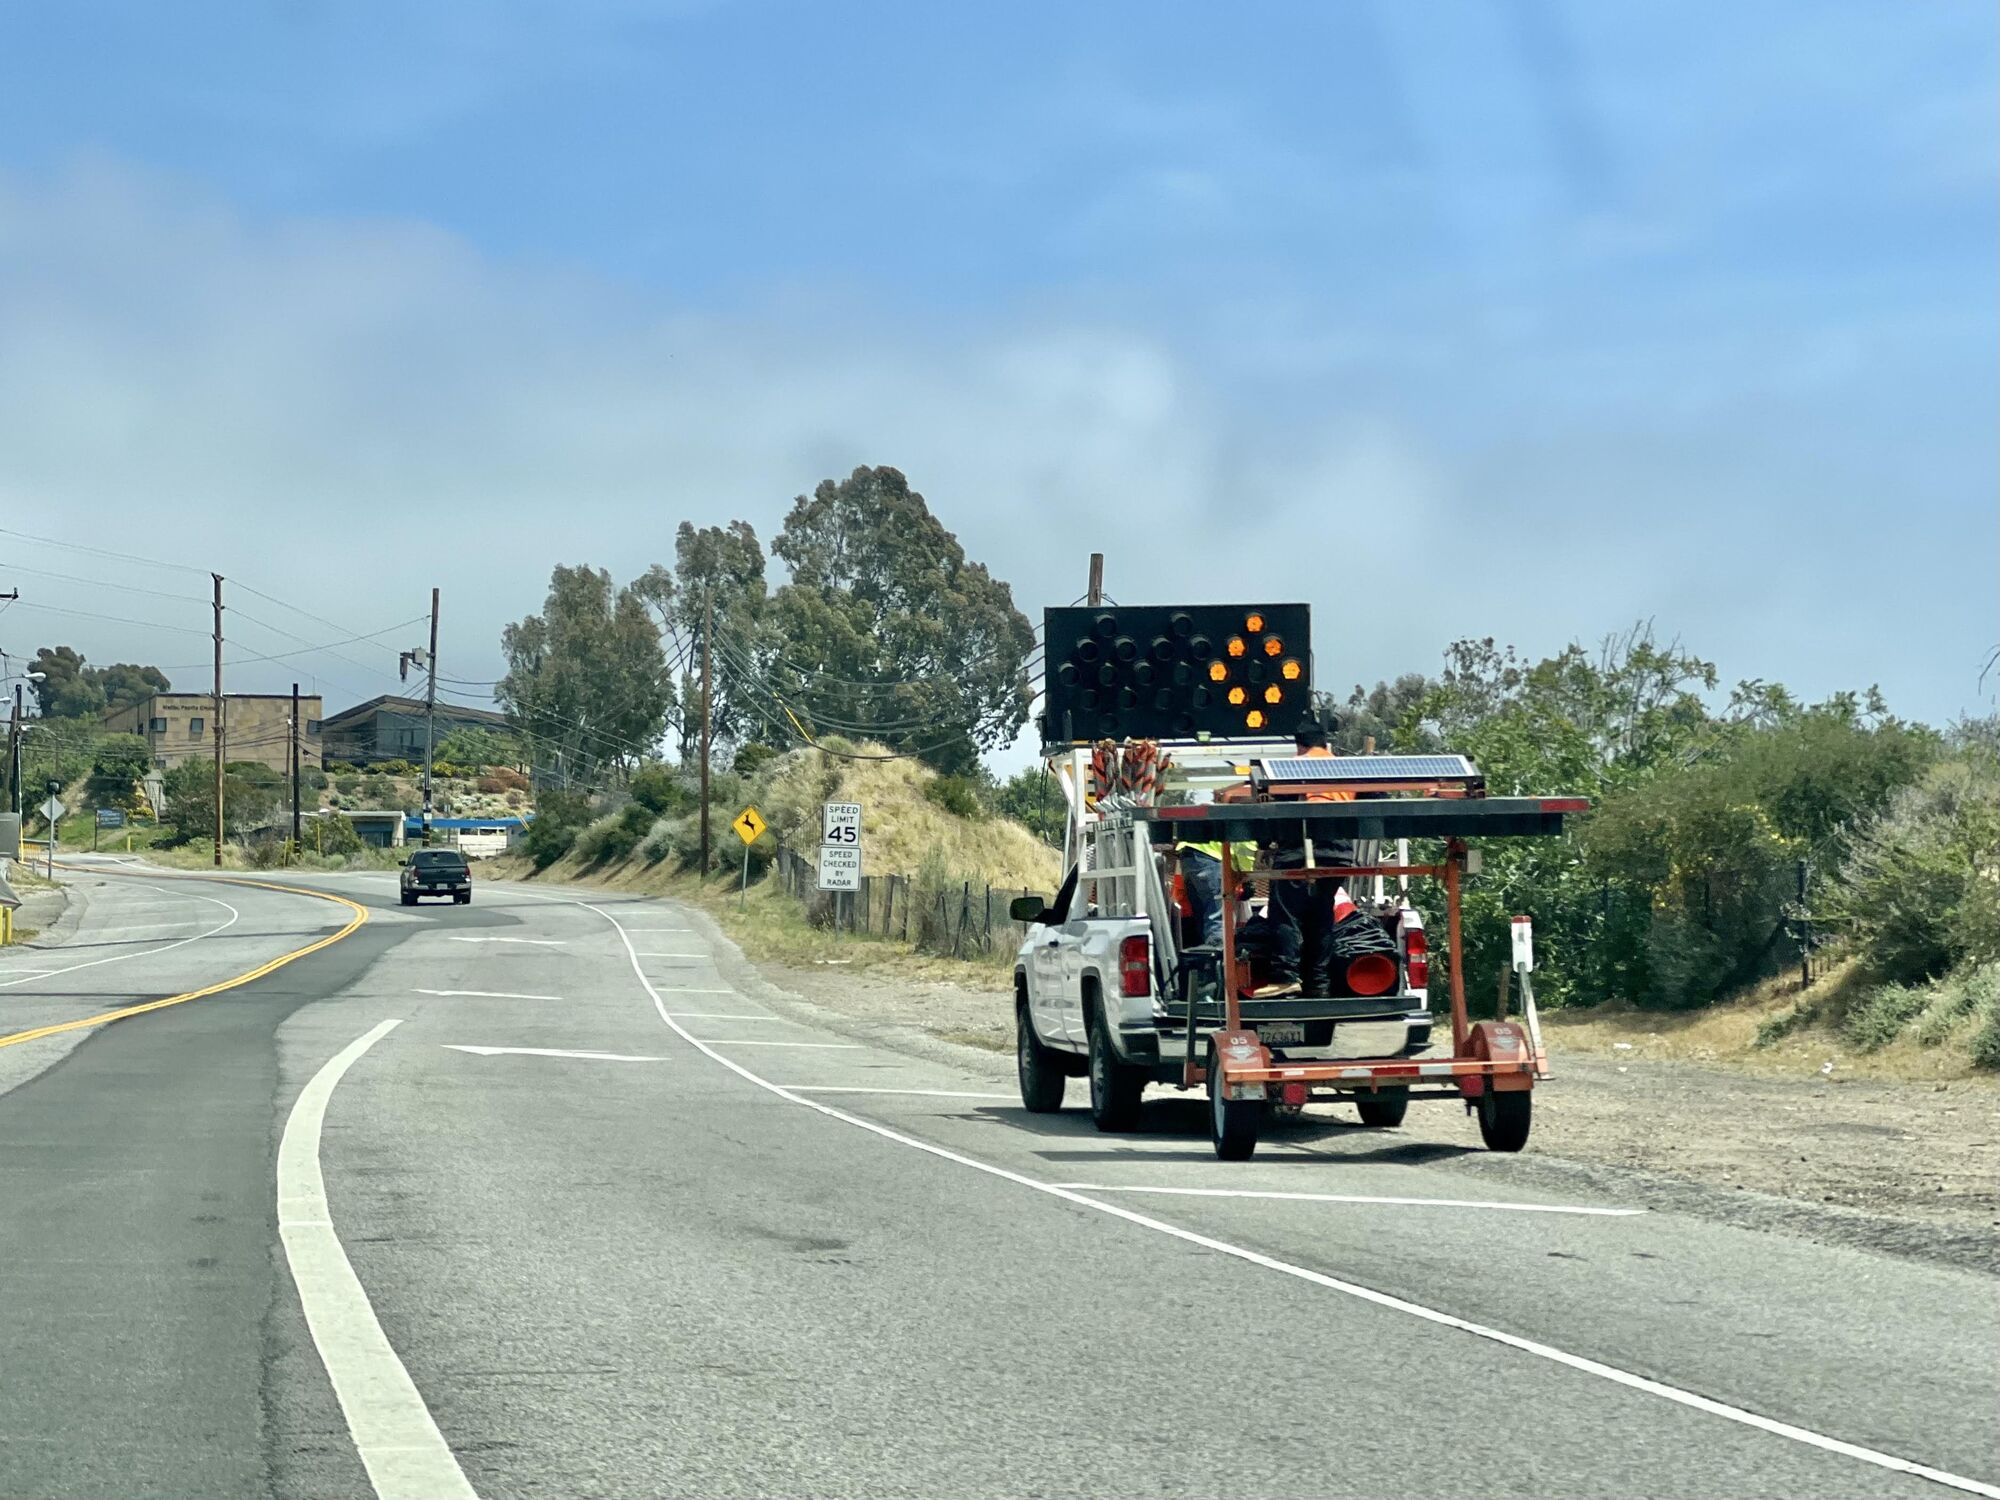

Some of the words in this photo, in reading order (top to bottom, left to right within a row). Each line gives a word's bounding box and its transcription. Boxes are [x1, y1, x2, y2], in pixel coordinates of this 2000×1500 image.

[829, 806, 858, 814] SPEED
[828, 826, 856, 842] 45
[823, 860, 857, 868] CHECKED
[1231, 1037, 1247, 1045] 05
